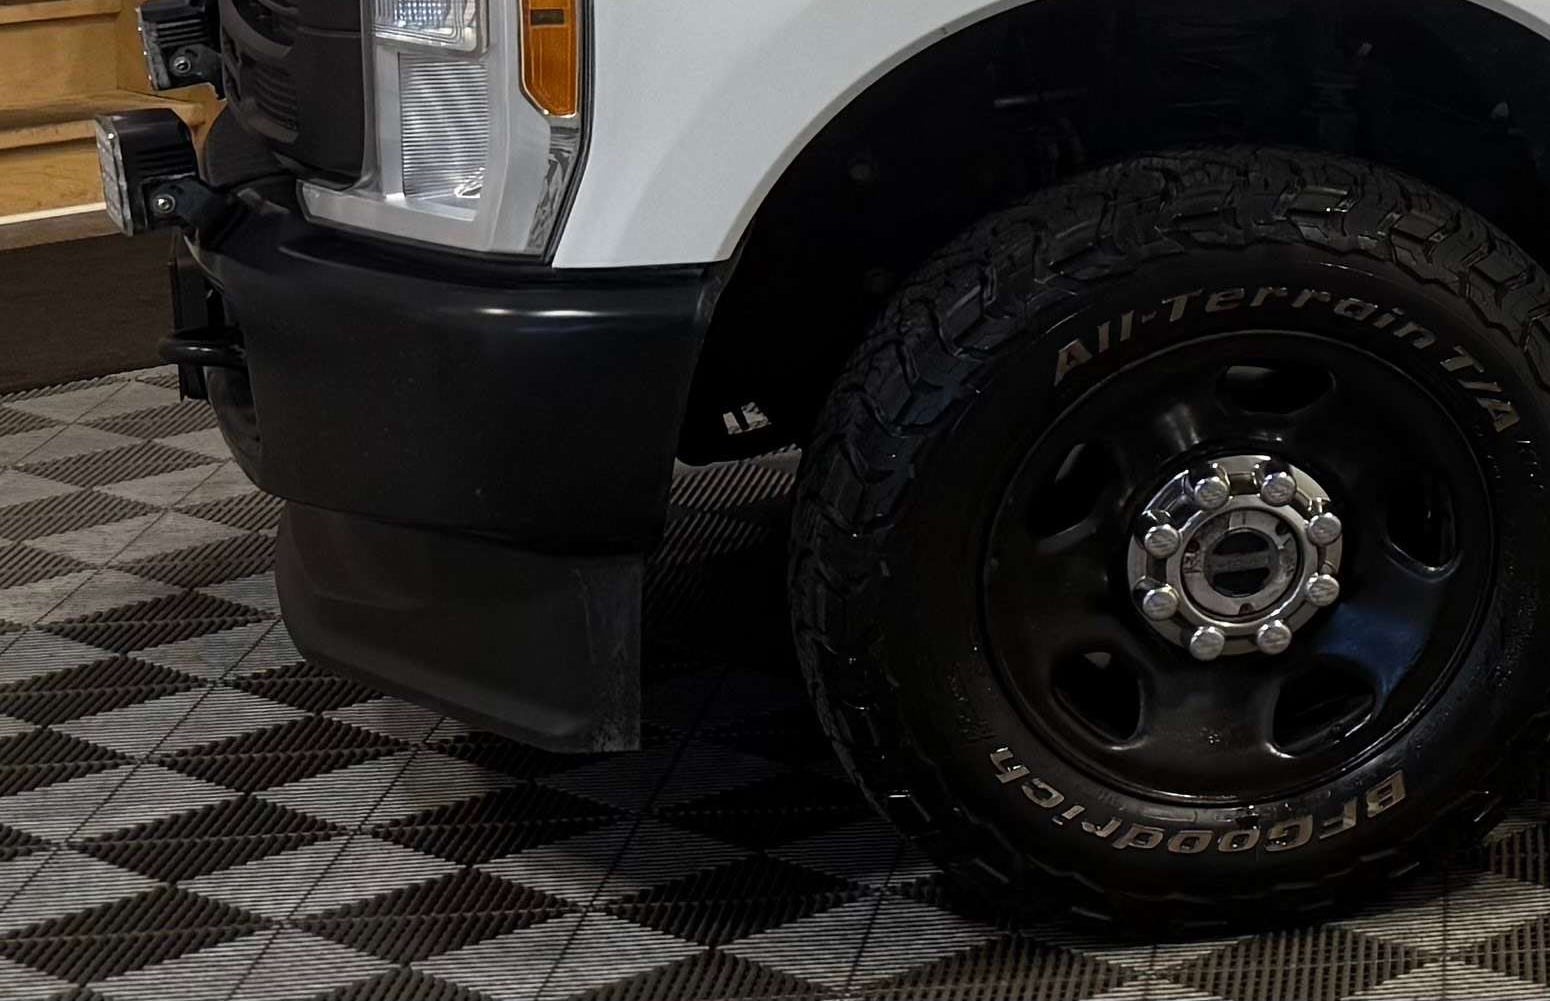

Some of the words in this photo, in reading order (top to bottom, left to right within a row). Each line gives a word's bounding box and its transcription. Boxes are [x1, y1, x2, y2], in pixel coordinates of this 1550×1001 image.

[1053, 286, 1437, 387] All-Terrain
[1439, 344, 1521, 432] T/A
[989, 745, 1407, 855] BFGoodrich
